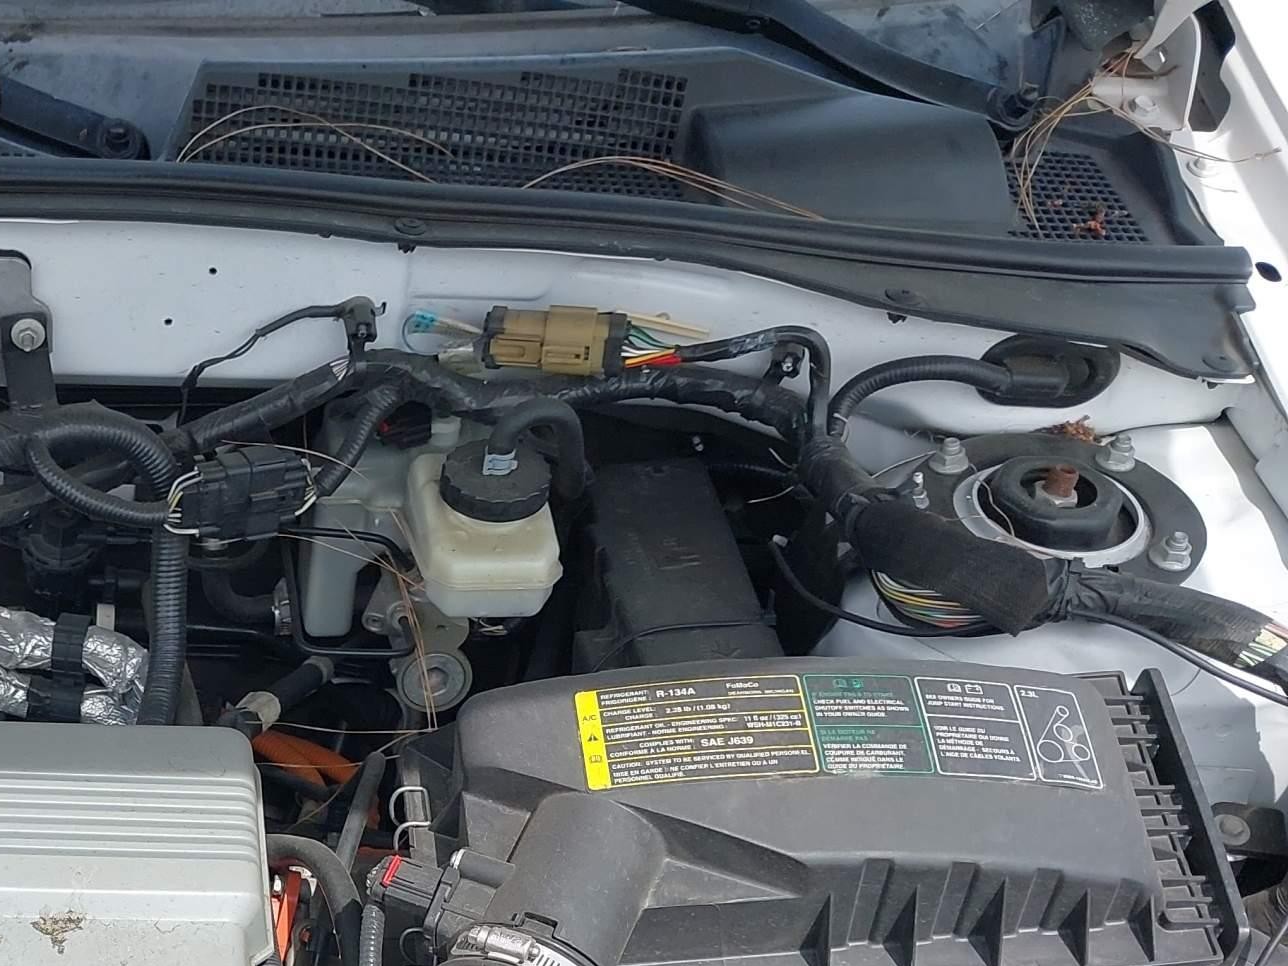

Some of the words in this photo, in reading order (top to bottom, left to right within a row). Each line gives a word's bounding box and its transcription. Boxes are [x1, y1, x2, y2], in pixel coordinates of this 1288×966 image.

[656, 688, 696, 698] R-134A
[1020, 690, 1039, 698] 2.3L
[700, 738, 725, 746] SAE
[728, 736, 754, 744] J639
